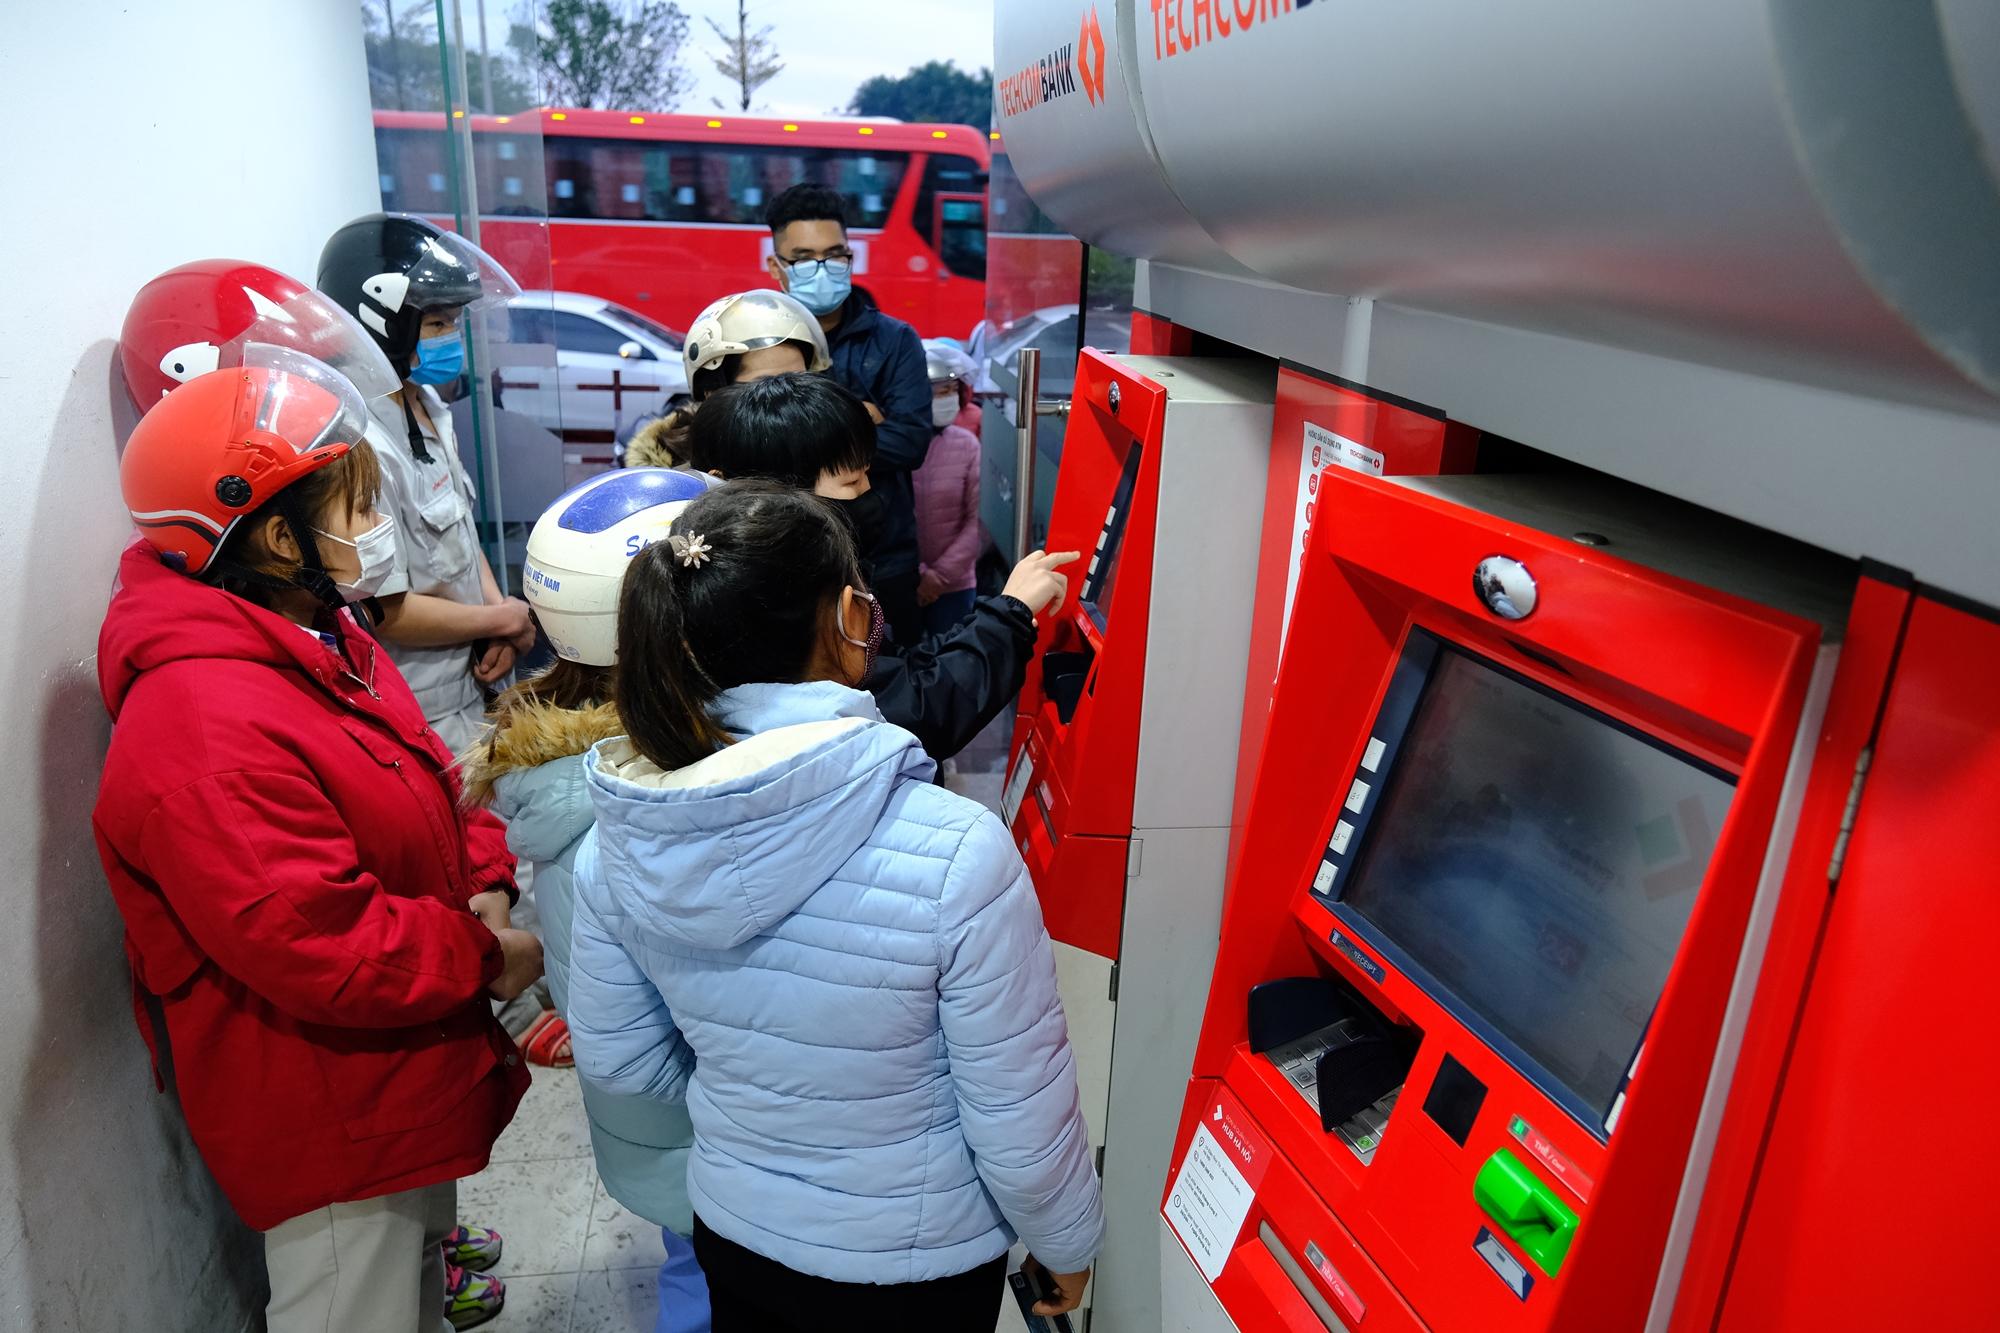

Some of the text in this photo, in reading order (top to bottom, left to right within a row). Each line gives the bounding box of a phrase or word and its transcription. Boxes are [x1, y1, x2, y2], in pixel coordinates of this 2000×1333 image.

[1000, 43, 1075, 118] TECHCOMBANK
[544, 576, 560, 592] NAM
[1354, 950, 1375, 974] RECEIPT
[1222, 1122, 1251, 1163] HUB HÀ NỘI
